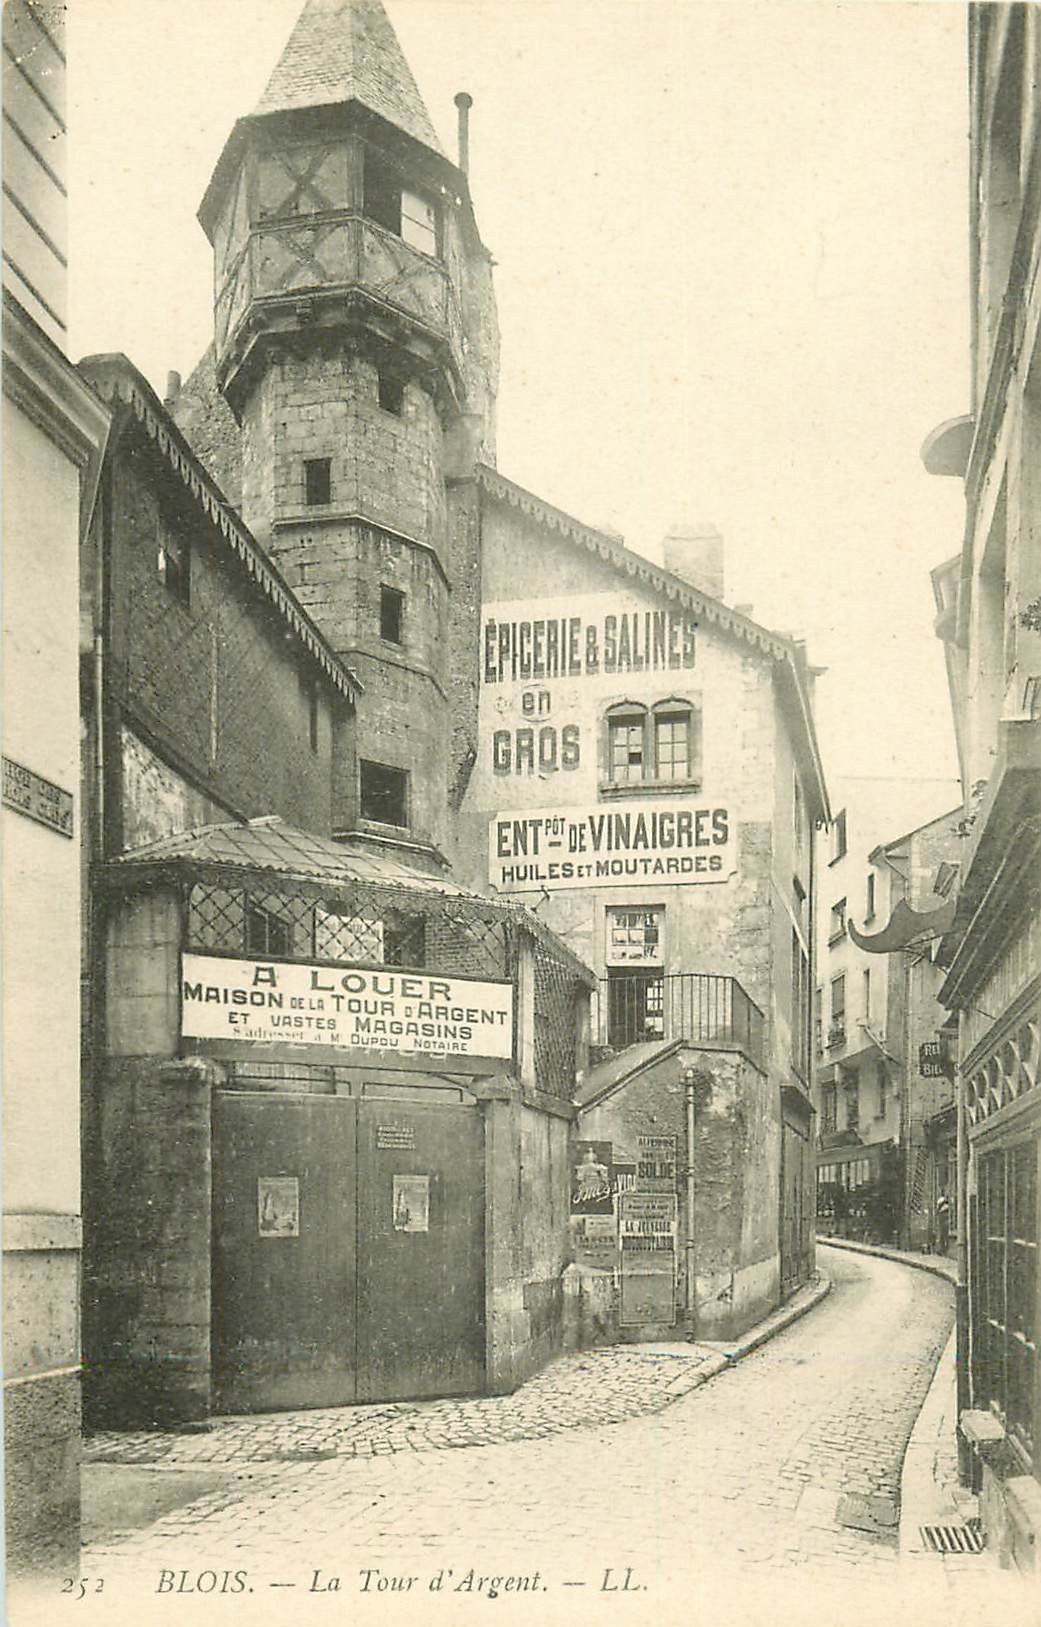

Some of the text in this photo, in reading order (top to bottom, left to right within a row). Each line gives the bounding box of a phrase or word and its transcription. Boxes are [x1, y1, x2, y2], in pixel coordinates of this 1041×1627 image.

[484, 610, 696, 684] ÉPICERIE & SALINES
[522, 690, 551, 716] en
[493, 725, 580, 777] GROS
[569, 824, 587, 853] DE
[588, 808, 729, 851] VINAIGRES
[502, 855, 723, 883] HUILES ET MOUTARDES
[183, 981, 283, 1009] MAISON
[290, 997, 305, 1010] DE
[309, 997, 324, 1010] LA
[331, 994, 395, 1017] TOUR
[252, 965, 451, 1001] A LOUER
[228, 1011, 472, 1040] ET VASTES MAGASINS
[414, 1039, 468, 1052] NOTAIRE
